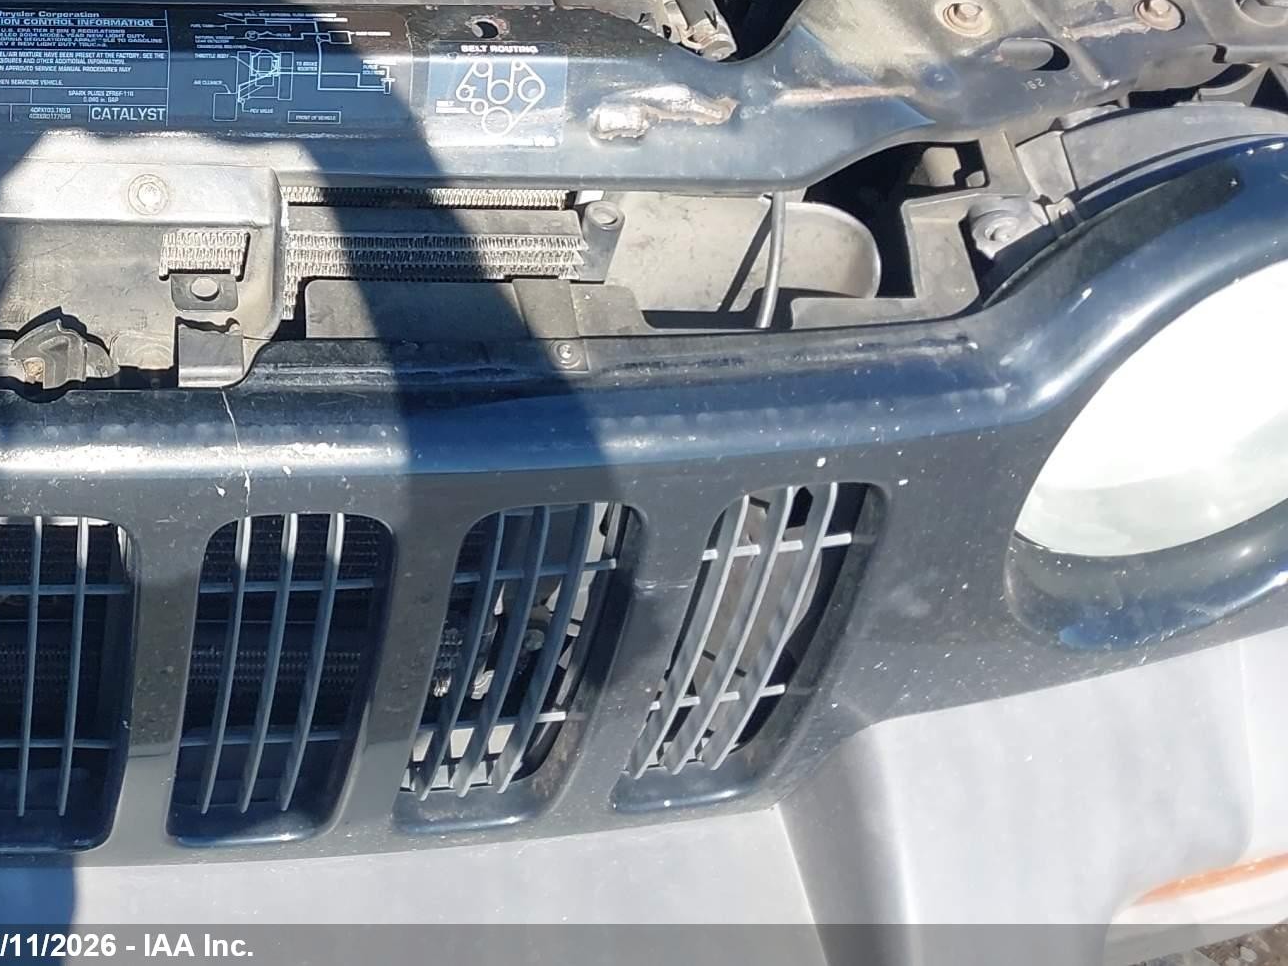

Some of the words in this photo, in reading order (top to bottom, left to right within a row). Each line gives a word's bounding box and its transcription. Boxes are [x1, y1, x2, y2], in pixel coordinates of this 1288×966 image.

[38, 10, 100, 19] Corporation
[23, 18, 73, 26] CONTROL
[460, 45, 487, 53] BELT
[489, 45, 538, 54] ROUTING
[91, 107, 166, 121] CATALYST
